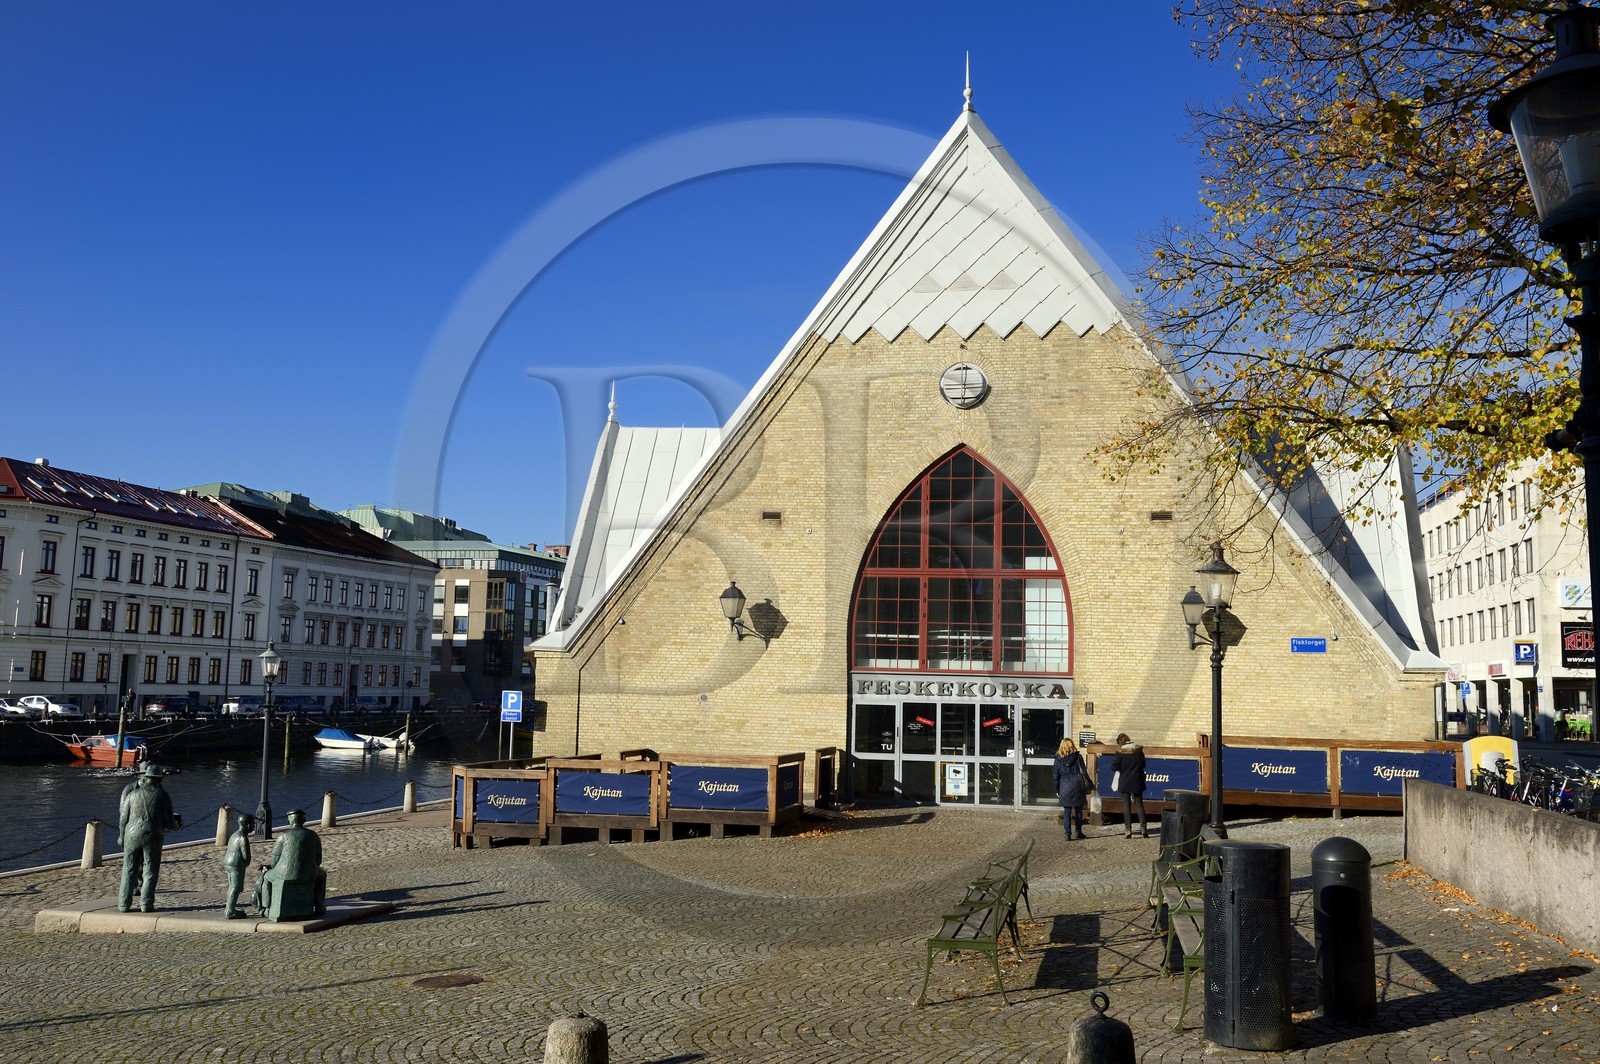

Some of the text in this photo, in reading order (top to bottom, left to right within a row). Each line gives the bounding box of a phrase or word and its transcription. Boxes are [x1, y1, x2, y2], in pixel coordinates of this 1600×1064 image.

[1292, 639, 1324, 647] Fisktorget
[1519, 645, 1531, 659] P
[856, 679, 1070, 700] FESKEKORKA
[507, 693, 518, 709] P
[1251, 762, 1297, 778] Kajutan
[1373, 765, 1420, 781] Kajutan
[583, 785, 623, 801] Kajutan
[698, 780, 740, 794] Kajutan
[487, 794, 527, 807] Kajutan
